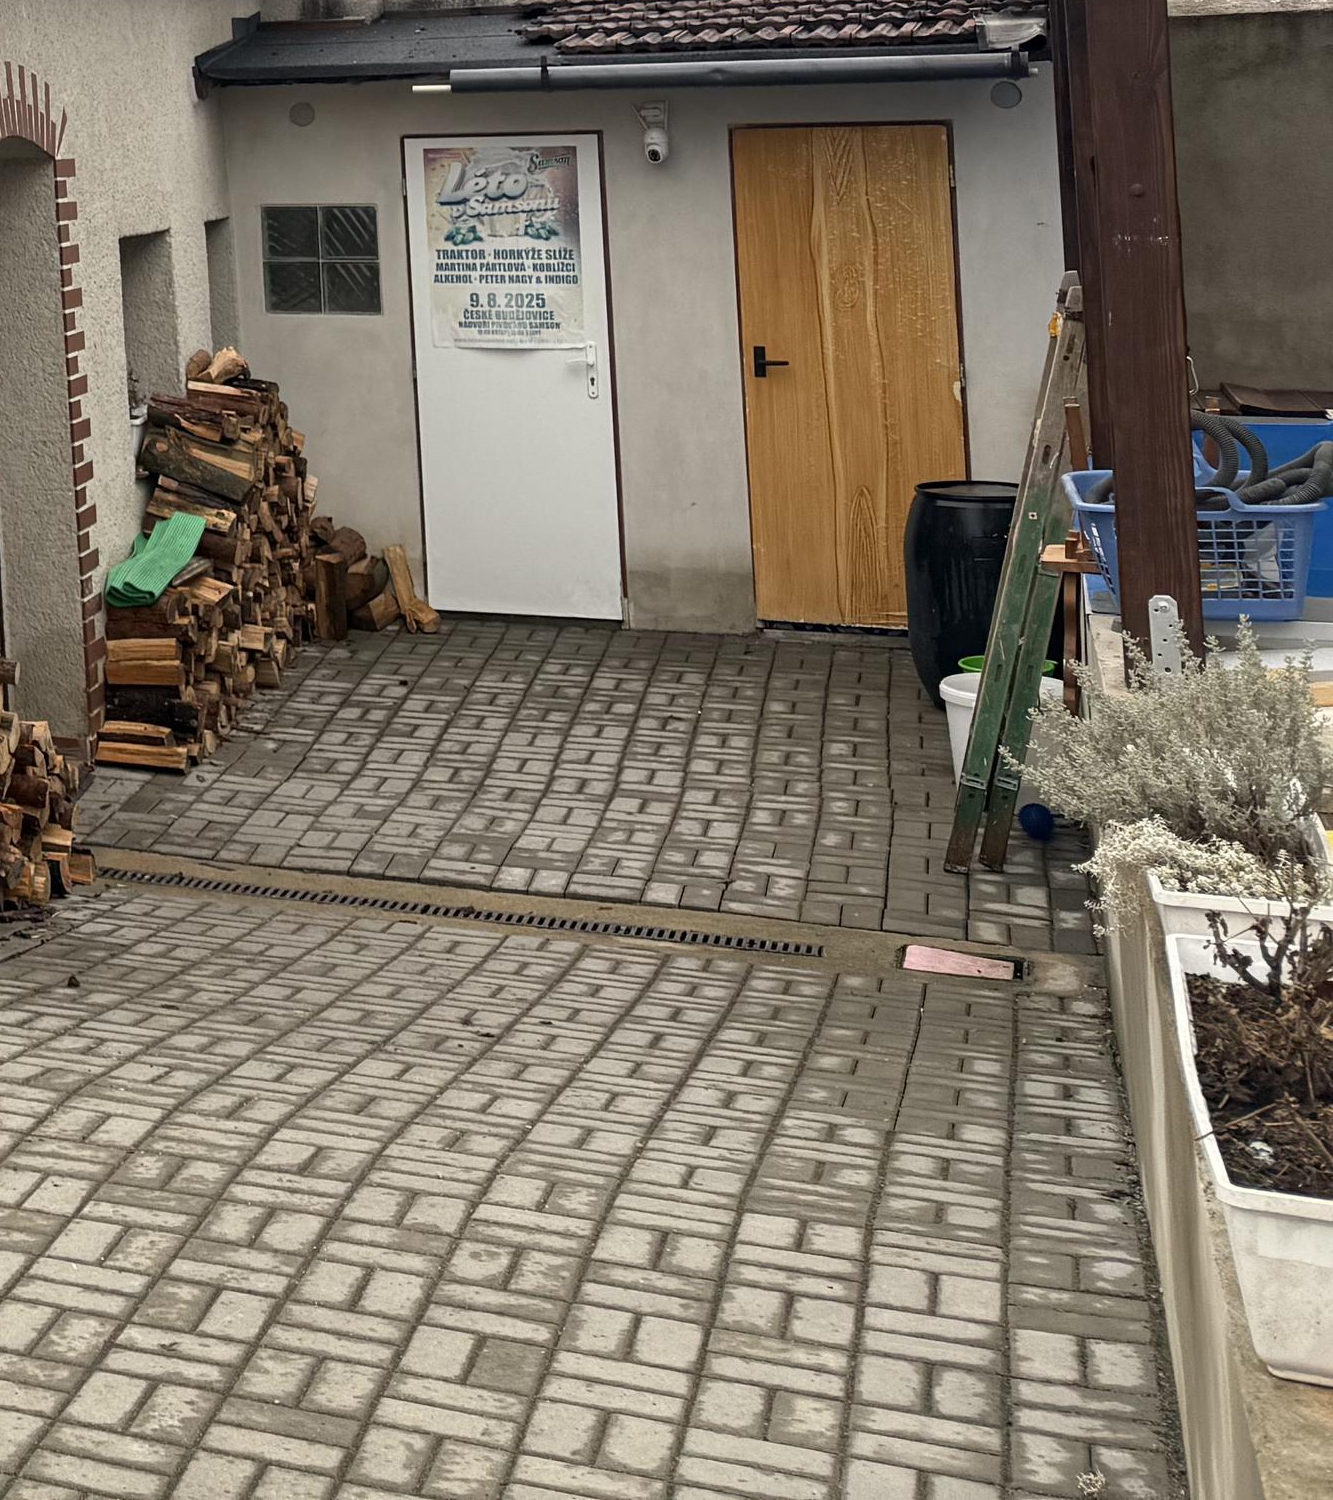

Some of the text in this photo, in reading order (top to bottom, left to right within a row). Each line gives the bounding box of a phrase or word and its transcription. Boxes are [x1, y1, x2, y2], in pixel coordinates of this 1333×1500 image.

[435, 161, 529, 205] Léto
[466, 196, 560, 218] Samsonu
[435, 247, 574, 260] TRAKTOR HORKÝŽE SLÍŽE
[436, 262, 477, 272] MARTINA
[480, 261, 526, 272] PÁRTLOVÁ
[434, 274, 578, 284] ALKEHOL PETER NAGY & INDIGO
[470, 293, 546, 308] 9. 8. 2025
[463, 309, 555, 321] ČESKÉ BUDĚJOVICE
